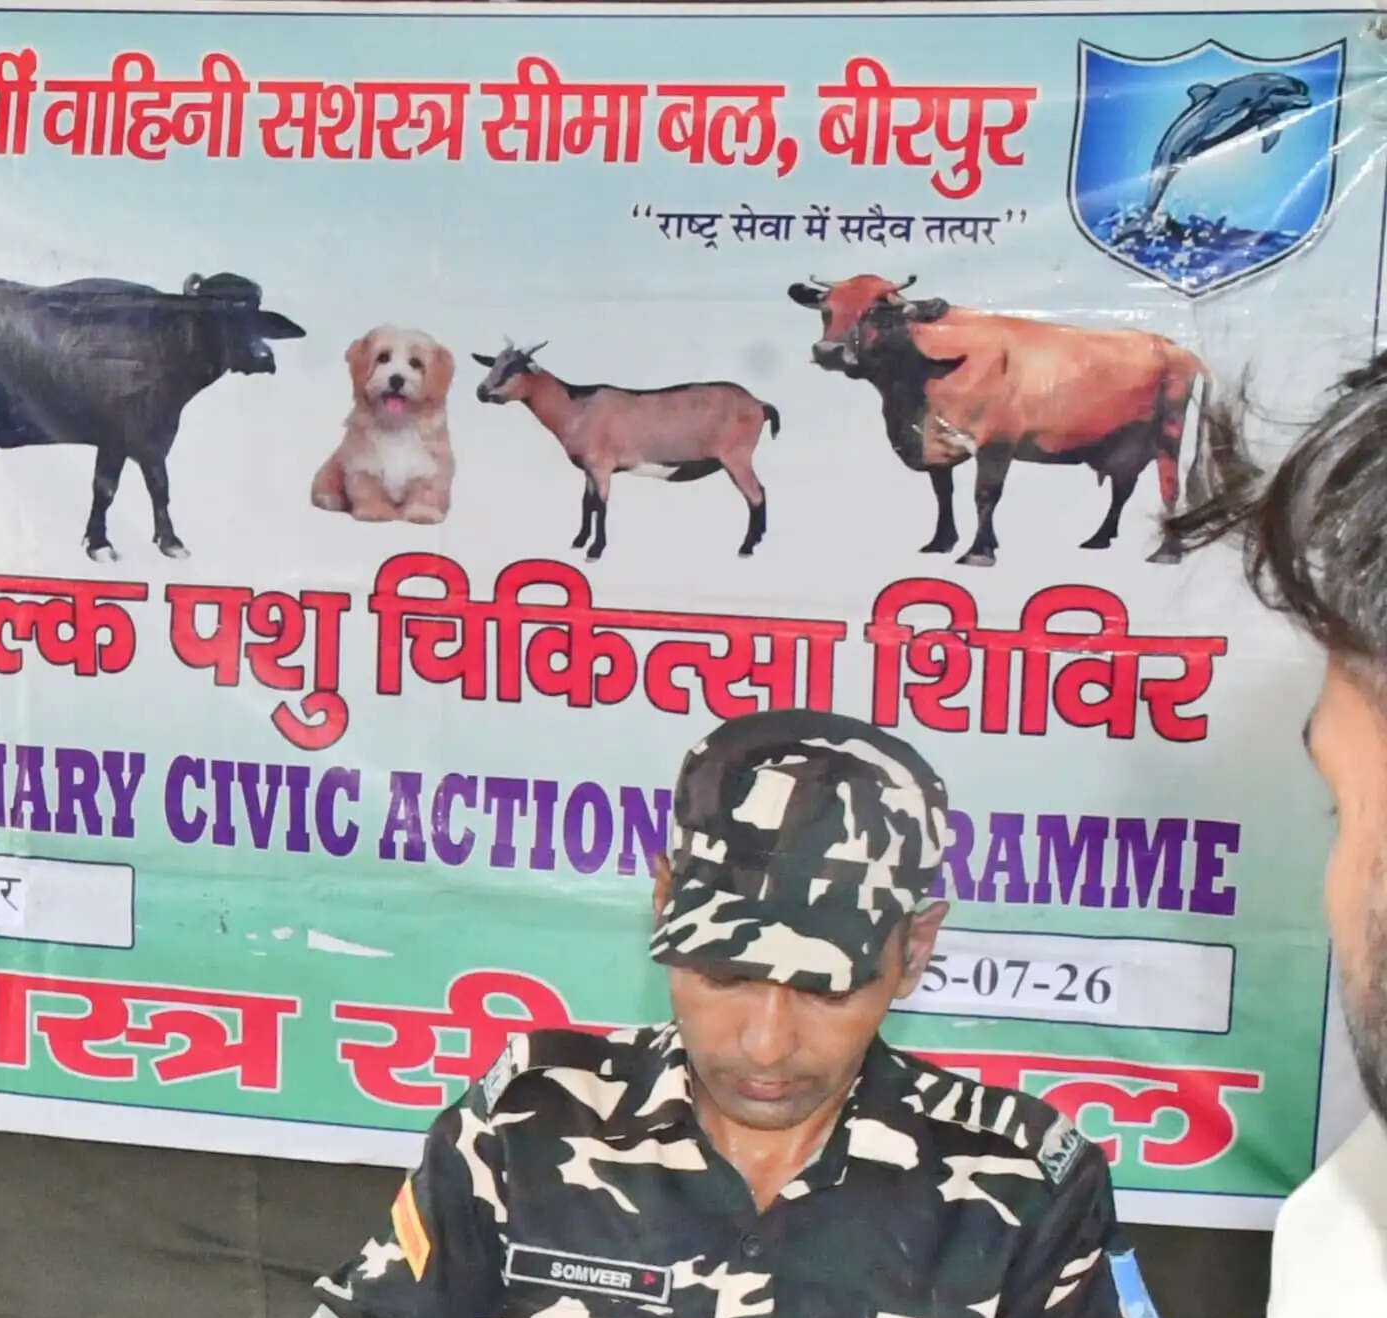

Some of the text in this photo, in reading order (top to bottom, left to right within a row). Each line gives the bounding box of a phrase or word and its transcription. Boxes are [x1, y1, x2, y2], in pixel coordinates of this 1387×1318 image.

[43, 52, 250, 160] वाहिनी
[258, 80, 471, 162] सशस्त्र
[479, 56, 643, 164] सीमा
[657, 84, 798, 178] बल,
[817, 58, 1037, 199] बीरपुर
[729, 206, 795, 245] सेवा
[803, 204, 832, 244] में
[837, 207, 915, 248] सदैव
[165, 583, 351, 751] पशु
[369, 551, 847, 721] चिकित्सा
[863, 577, 1228, 744] शिविर
[164, 755, 361, 859] CIVIC
[377, 770, 674, 881] ACTION
[930, 809, 1241, 916] RAMME
[921, 954, 1114, 1006] 5-07-26
[549, 1261, 633, 1289] SOMVEER
